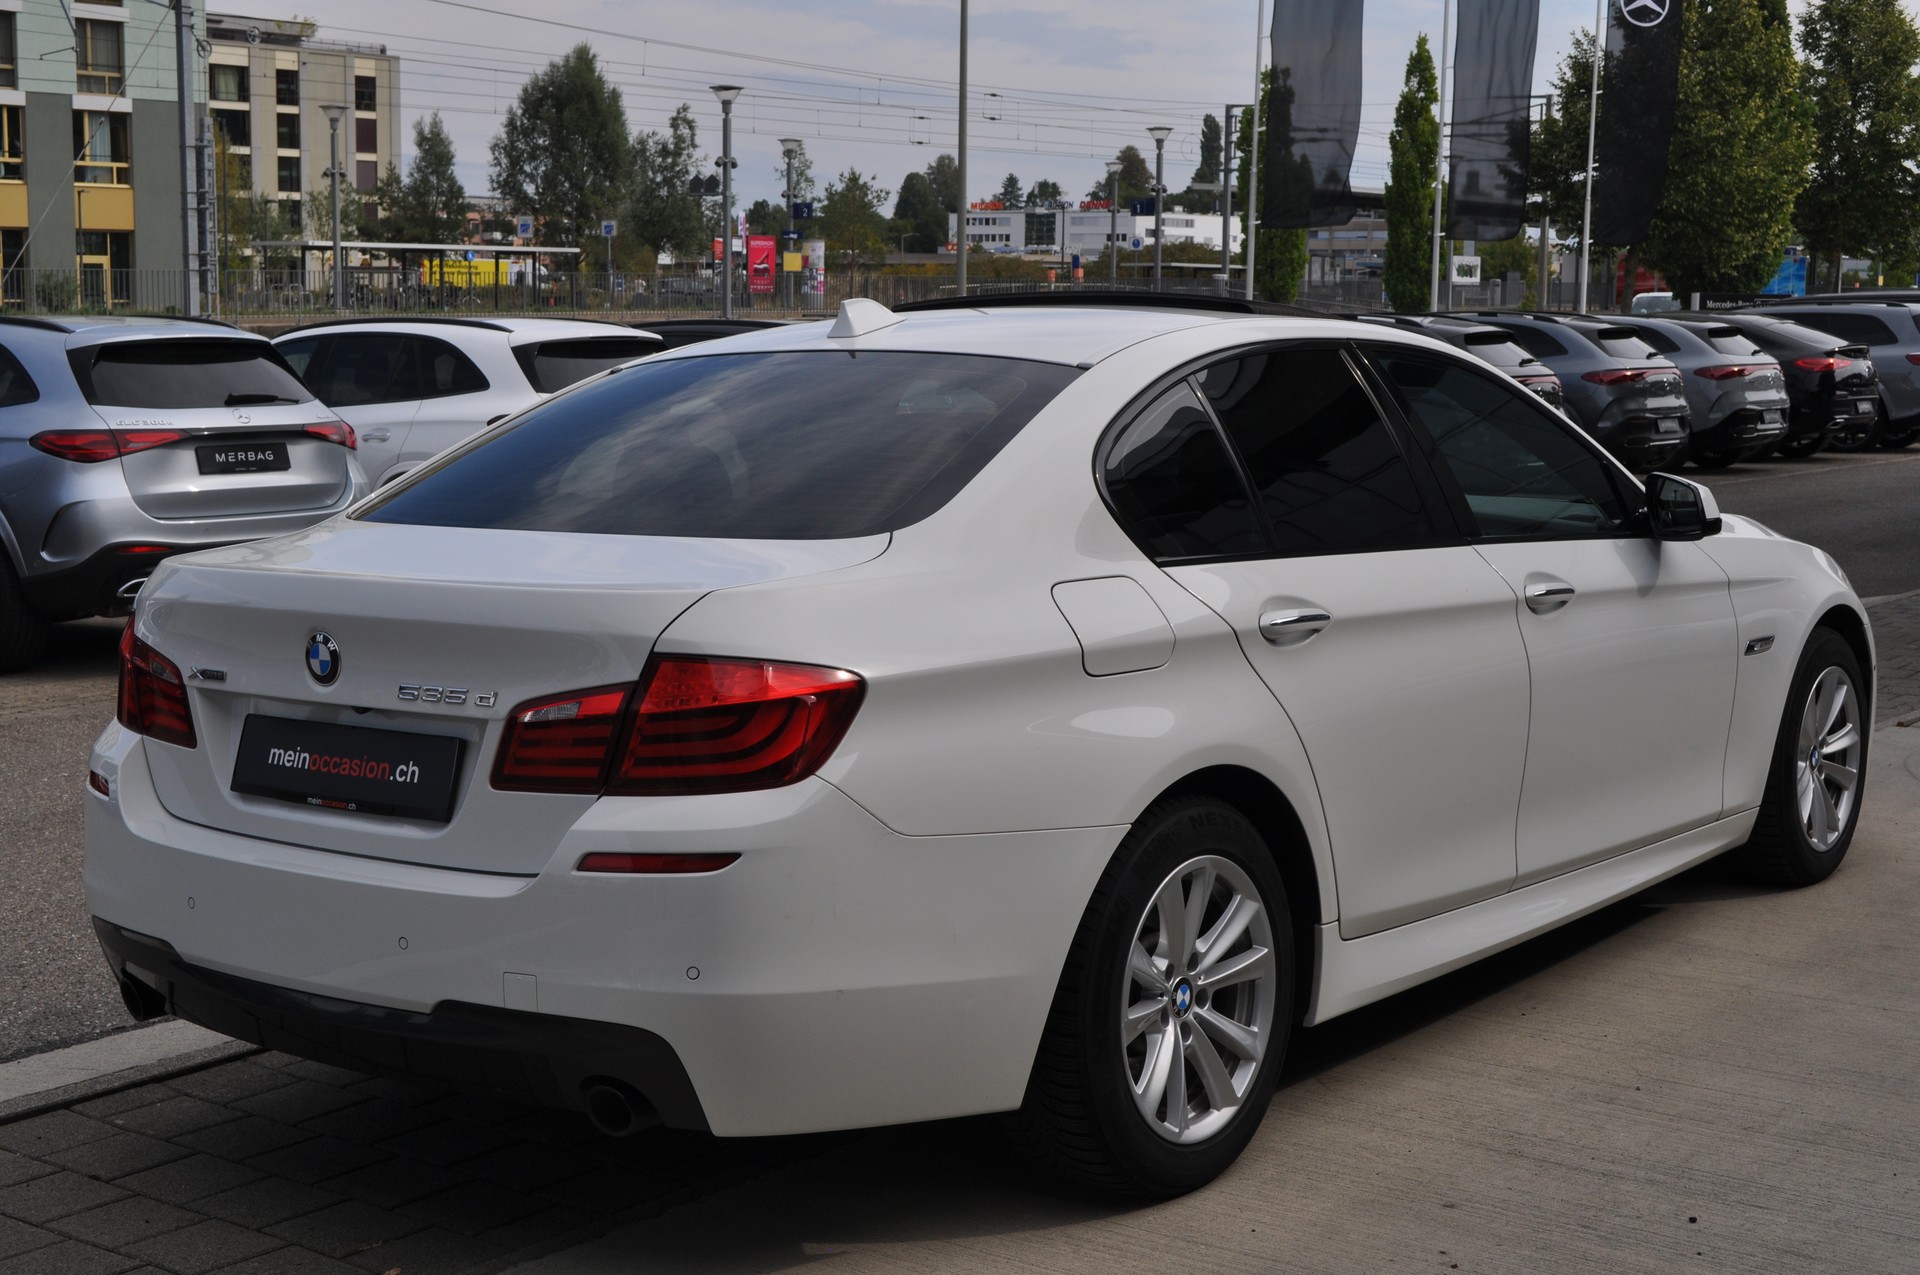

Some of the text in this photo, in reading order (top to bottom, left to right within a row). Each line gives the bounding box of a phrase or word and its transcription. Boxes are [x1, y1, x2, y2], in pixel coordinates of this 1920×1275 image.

[1079, 199, 1114, 209] DENNE
[1136, 203, 1140, 214] 1
[802, 207, 808, 217] 2
[215, 451, 274, 463] MERBAG
[398, 683, 498, 708] 535 d
[268, 746, 420, 784] meinoccasion.ch
[307, 796, 357, 811] meinoccasion.ch
